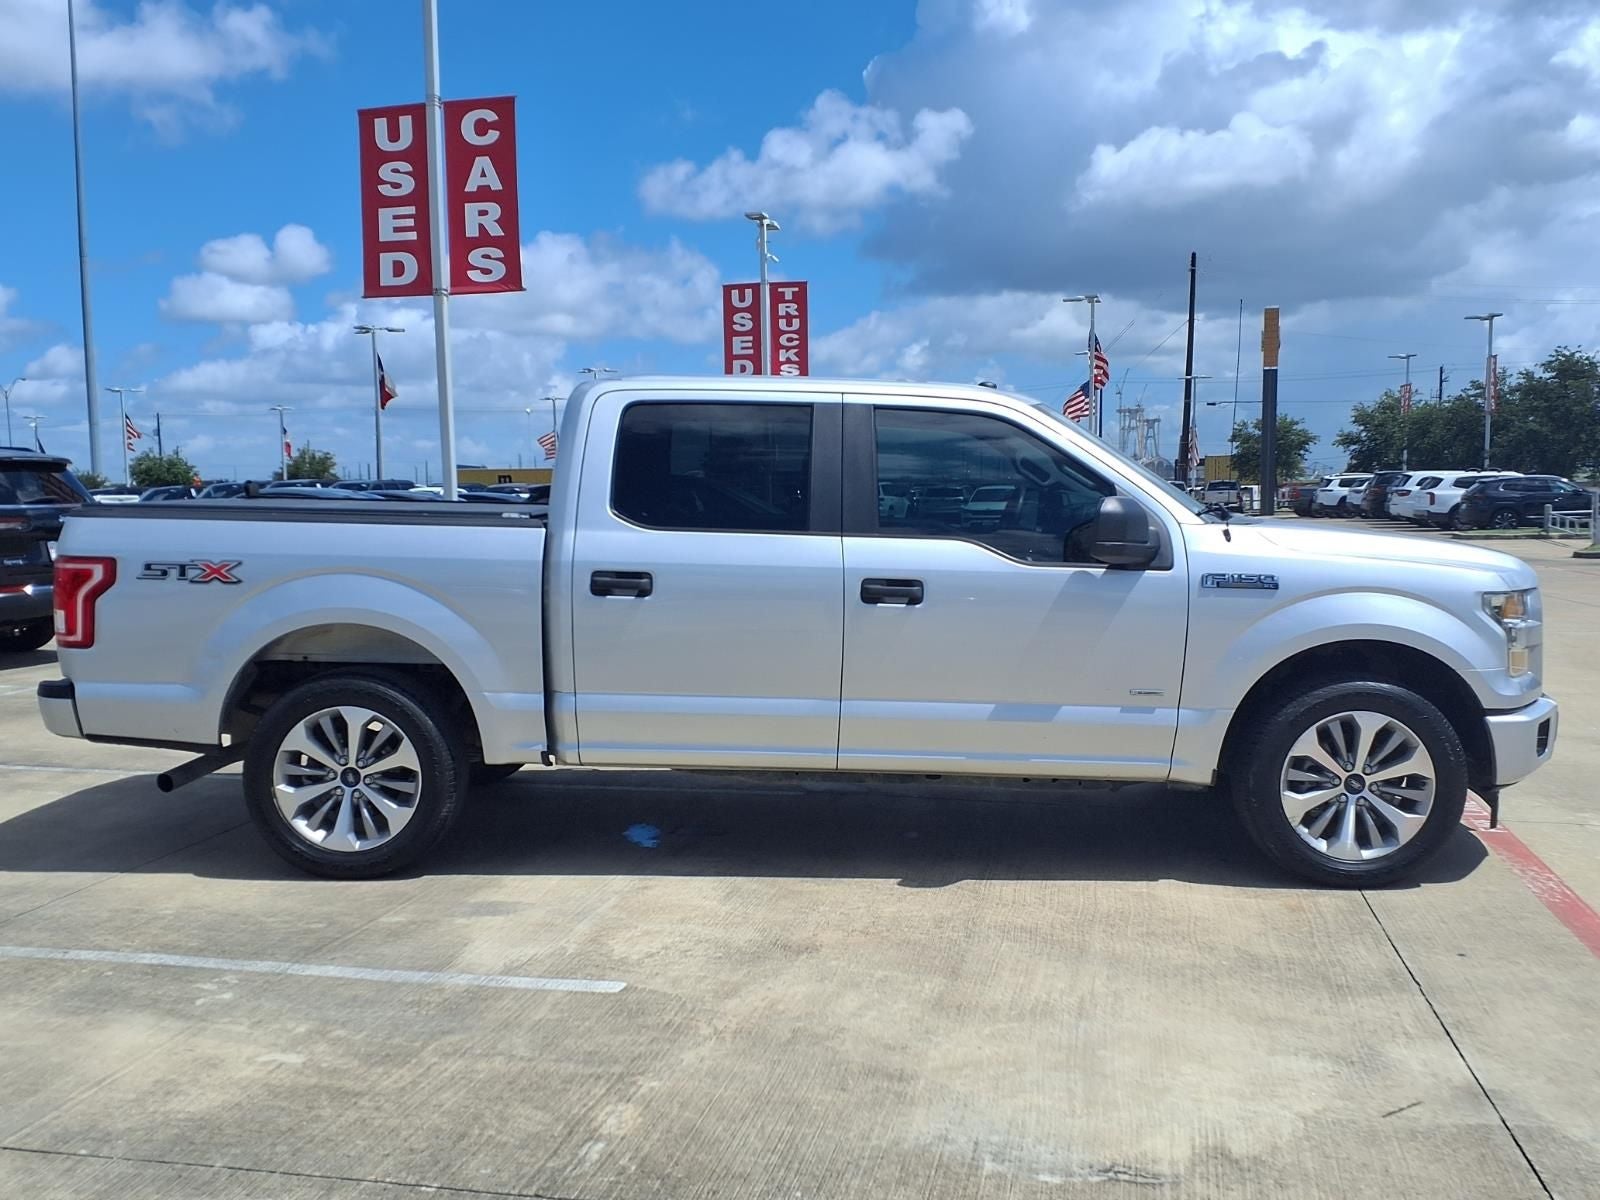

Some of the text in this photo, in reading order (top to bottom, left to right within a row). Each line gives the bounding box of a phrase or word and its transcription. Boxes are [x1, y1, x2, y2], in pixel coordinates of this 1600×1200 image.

[373, 115, 418, 286] USED
[460, 109, 506, 282] CARS
[731, 288, 754, 375] USED
[777, 287, 800, 376] TRUCKS
[136, 560, 243, 584] STX
